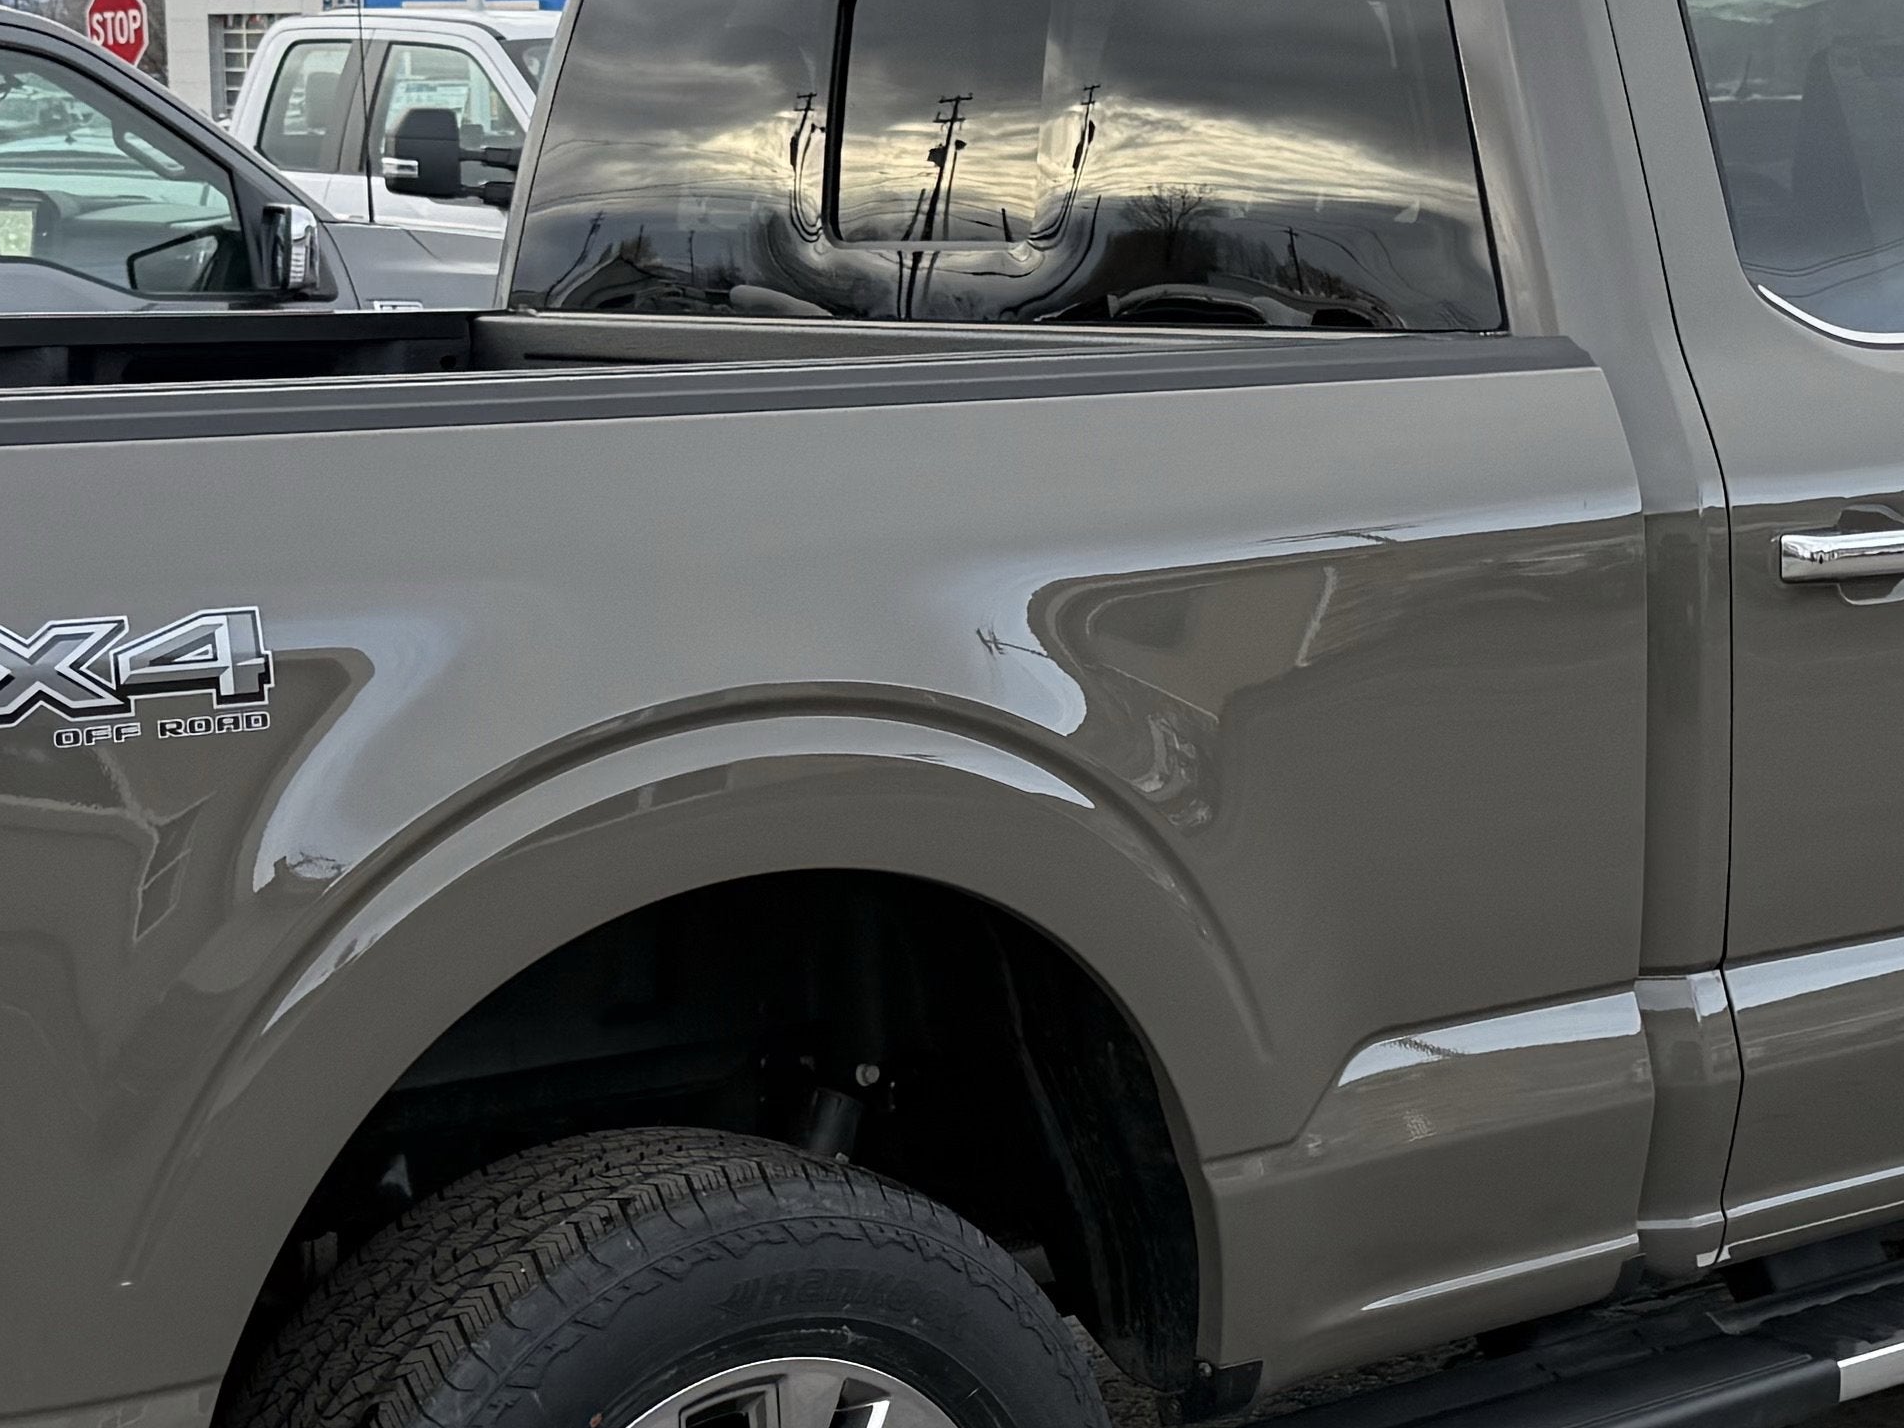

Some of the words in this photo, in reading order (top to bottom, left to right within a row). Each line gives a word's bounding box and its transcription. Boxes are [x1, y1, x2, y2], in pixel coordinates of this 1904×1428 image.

[91, 8, 142, 47] STOP
[53, 722, 142, 749] OFF
[157, 710, 272, 741] ROAD
